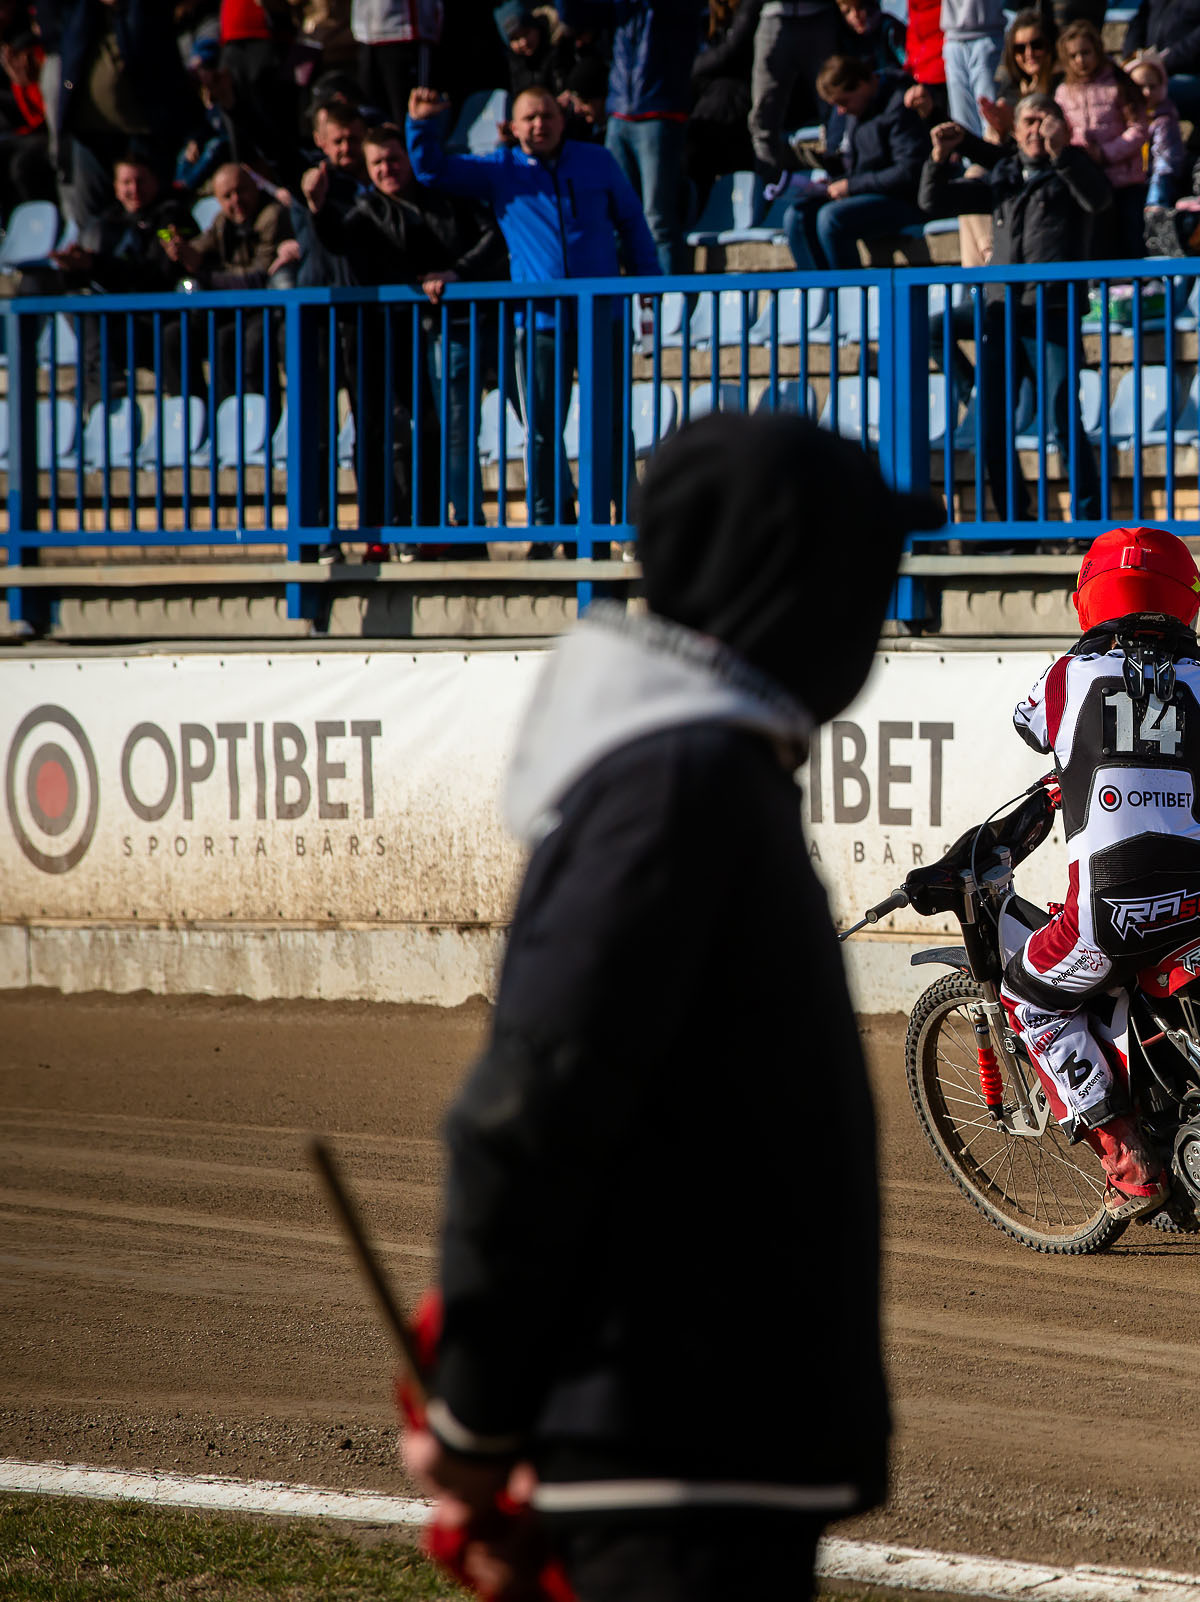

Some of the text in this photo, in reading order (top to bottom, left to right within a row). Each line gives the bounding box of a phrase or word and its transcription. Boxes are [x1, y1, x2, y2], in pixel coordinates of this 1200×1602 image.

[1104, 691, 1182, 755] 14
[120, 719, 382, 822] OPTIBET
[809, 720, 955, 827] IBET
[1127, 790, 1192, 808] OPTIBET
[122, 829, 387, 858] SPORTA BĀRS
[1078, 1069, 1105, 1099] Systems
